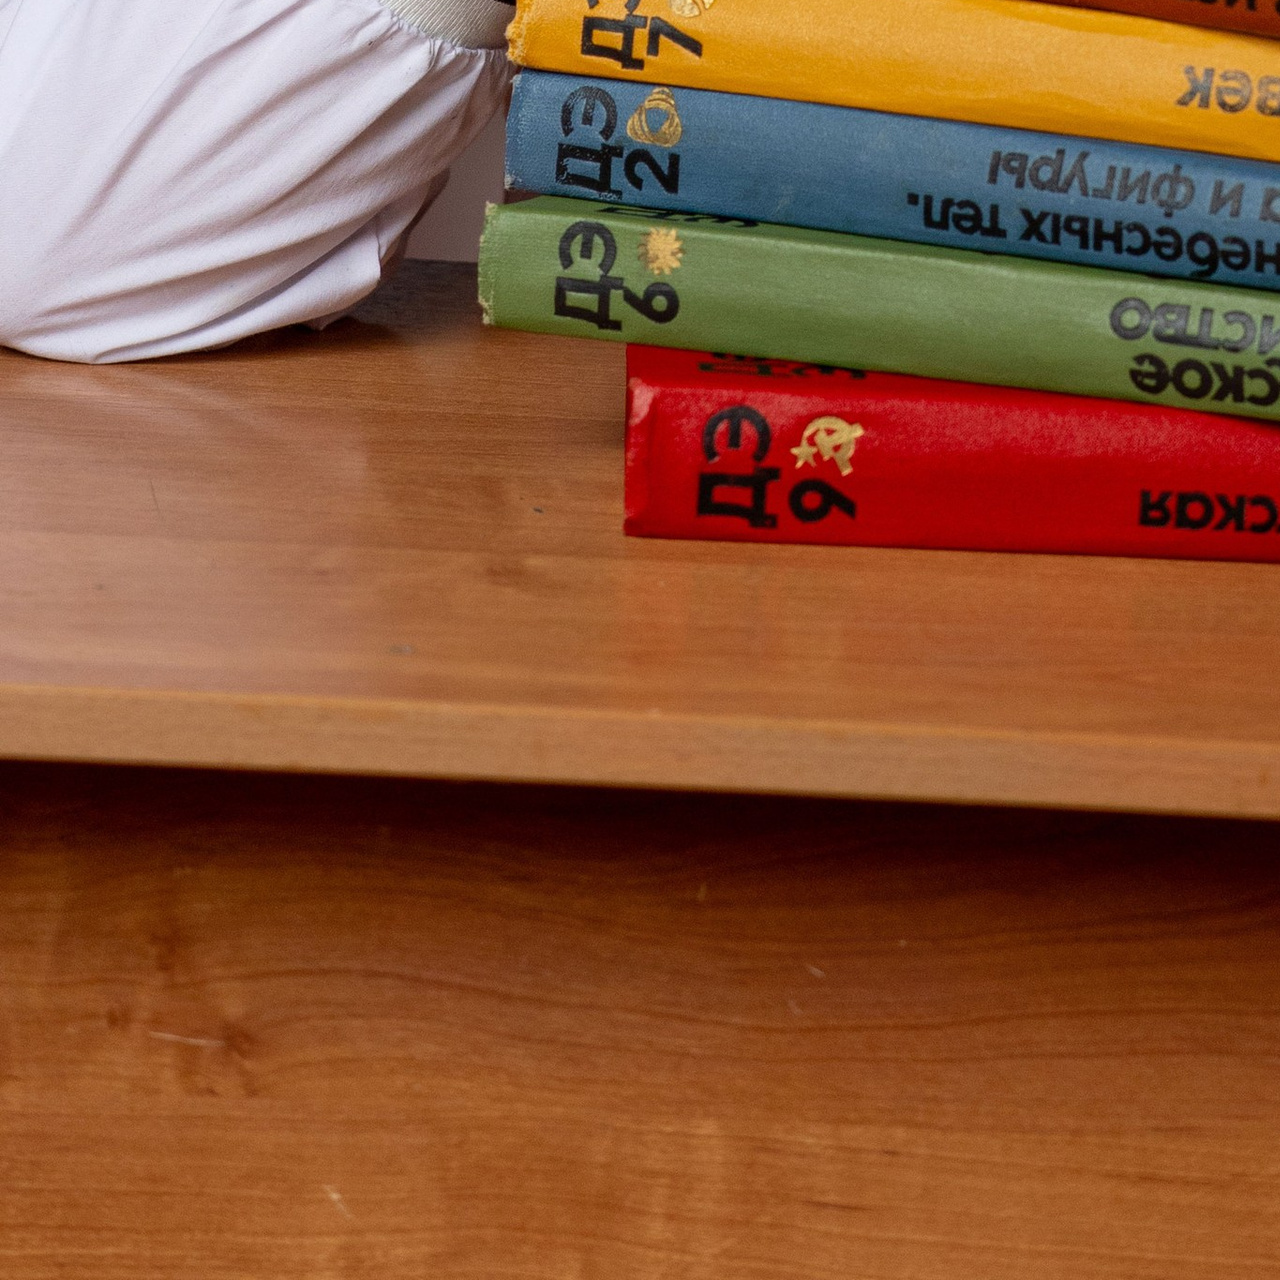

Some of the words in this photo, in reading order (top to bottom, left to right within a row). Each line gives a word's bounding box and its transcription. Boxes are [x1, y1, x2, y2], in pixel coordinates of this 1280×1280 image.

[646, 16, 704, 59] 7
[555, 85, 625, 200] ДЭ
[622, 151, 682, 195] 2
[987, 148, 1197, 215] фигуры
[906, 192, 1008, 238] тел.
[1208, 180, 1246, 217] и
[553, 220, 624, 331] ДЭ
[622, 282, 680, 324] 6
[697, 405, 781, 529] ДЭ
[788, 479, 857, 523] 9
